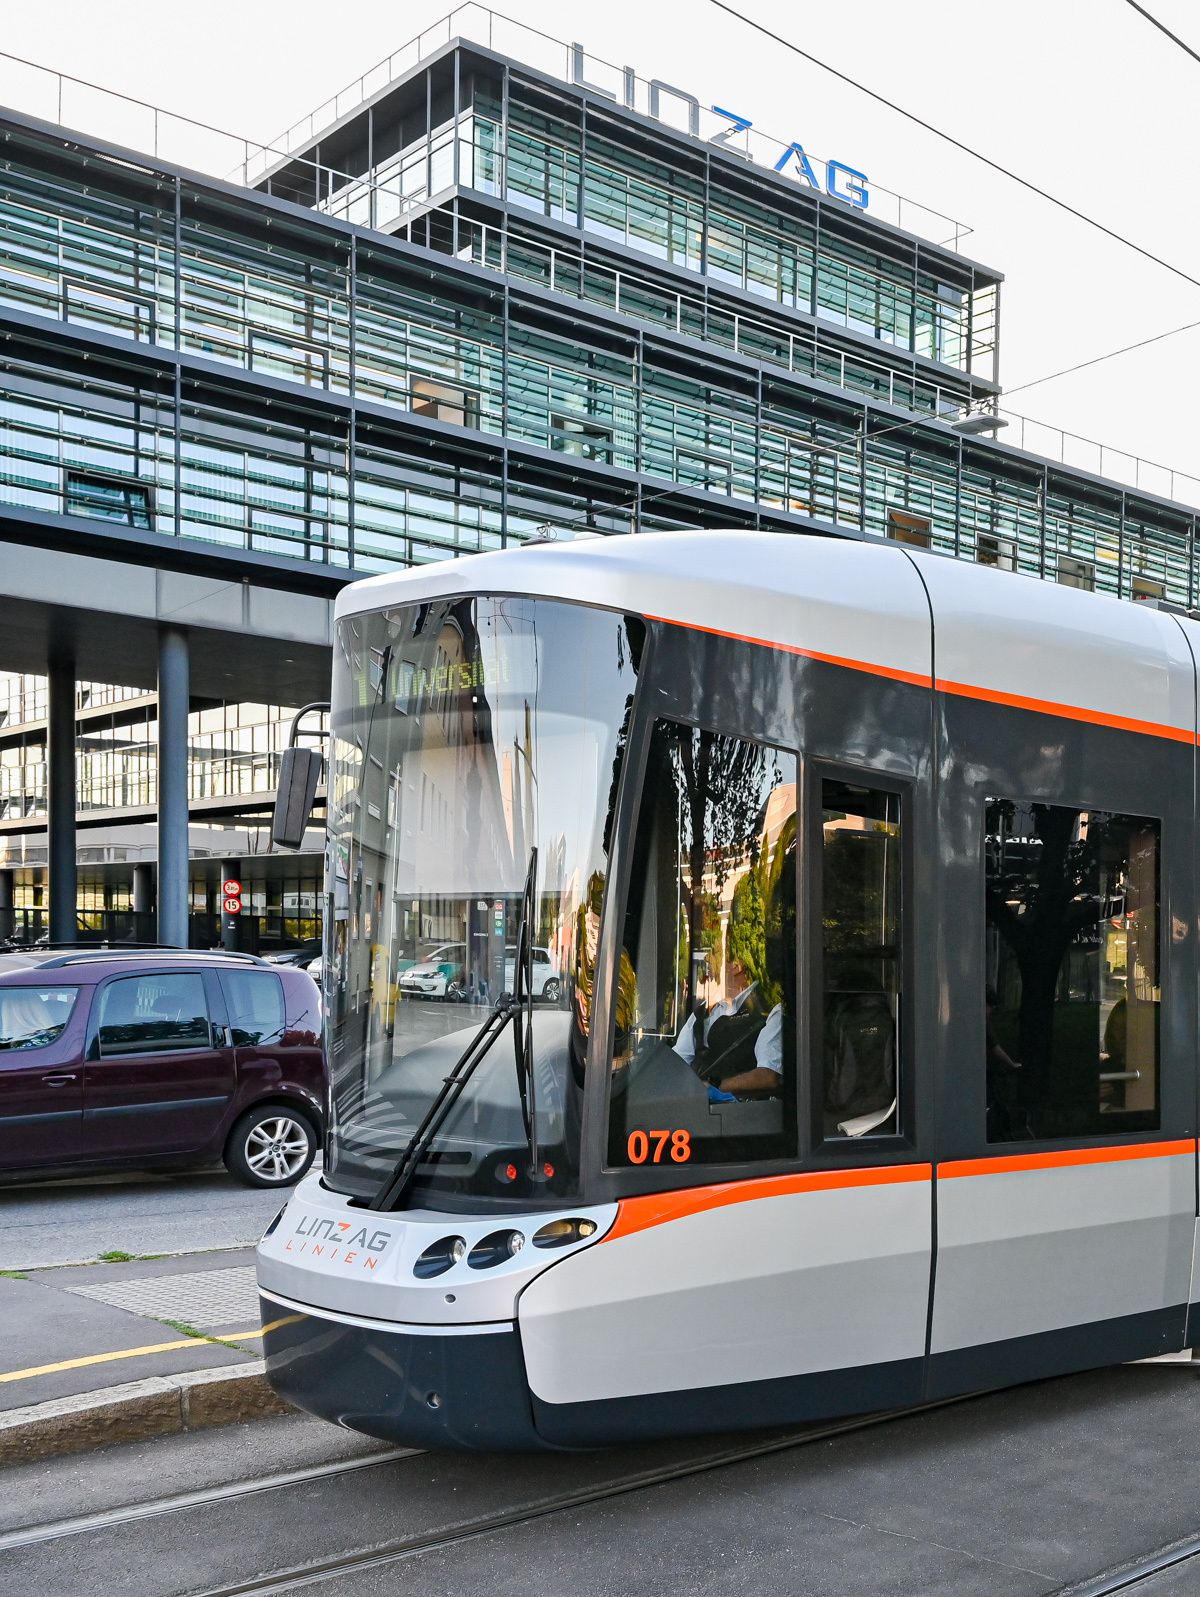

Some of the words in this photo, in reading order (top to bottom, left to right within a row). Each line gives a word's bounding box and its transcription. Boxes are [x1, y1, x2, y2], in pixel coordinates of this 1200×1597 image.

[572, 42, 753, 162] LINZ
[773, 142, 869, 210] AG
[227, 900, 237, 910] 15
[627, 1129, 691, 1165] 078
[295, 1216, 352, 1243] LINZ
[347, 1227, 392, 1252] AG
[285, 1239, 378, 1270] LINIEN
